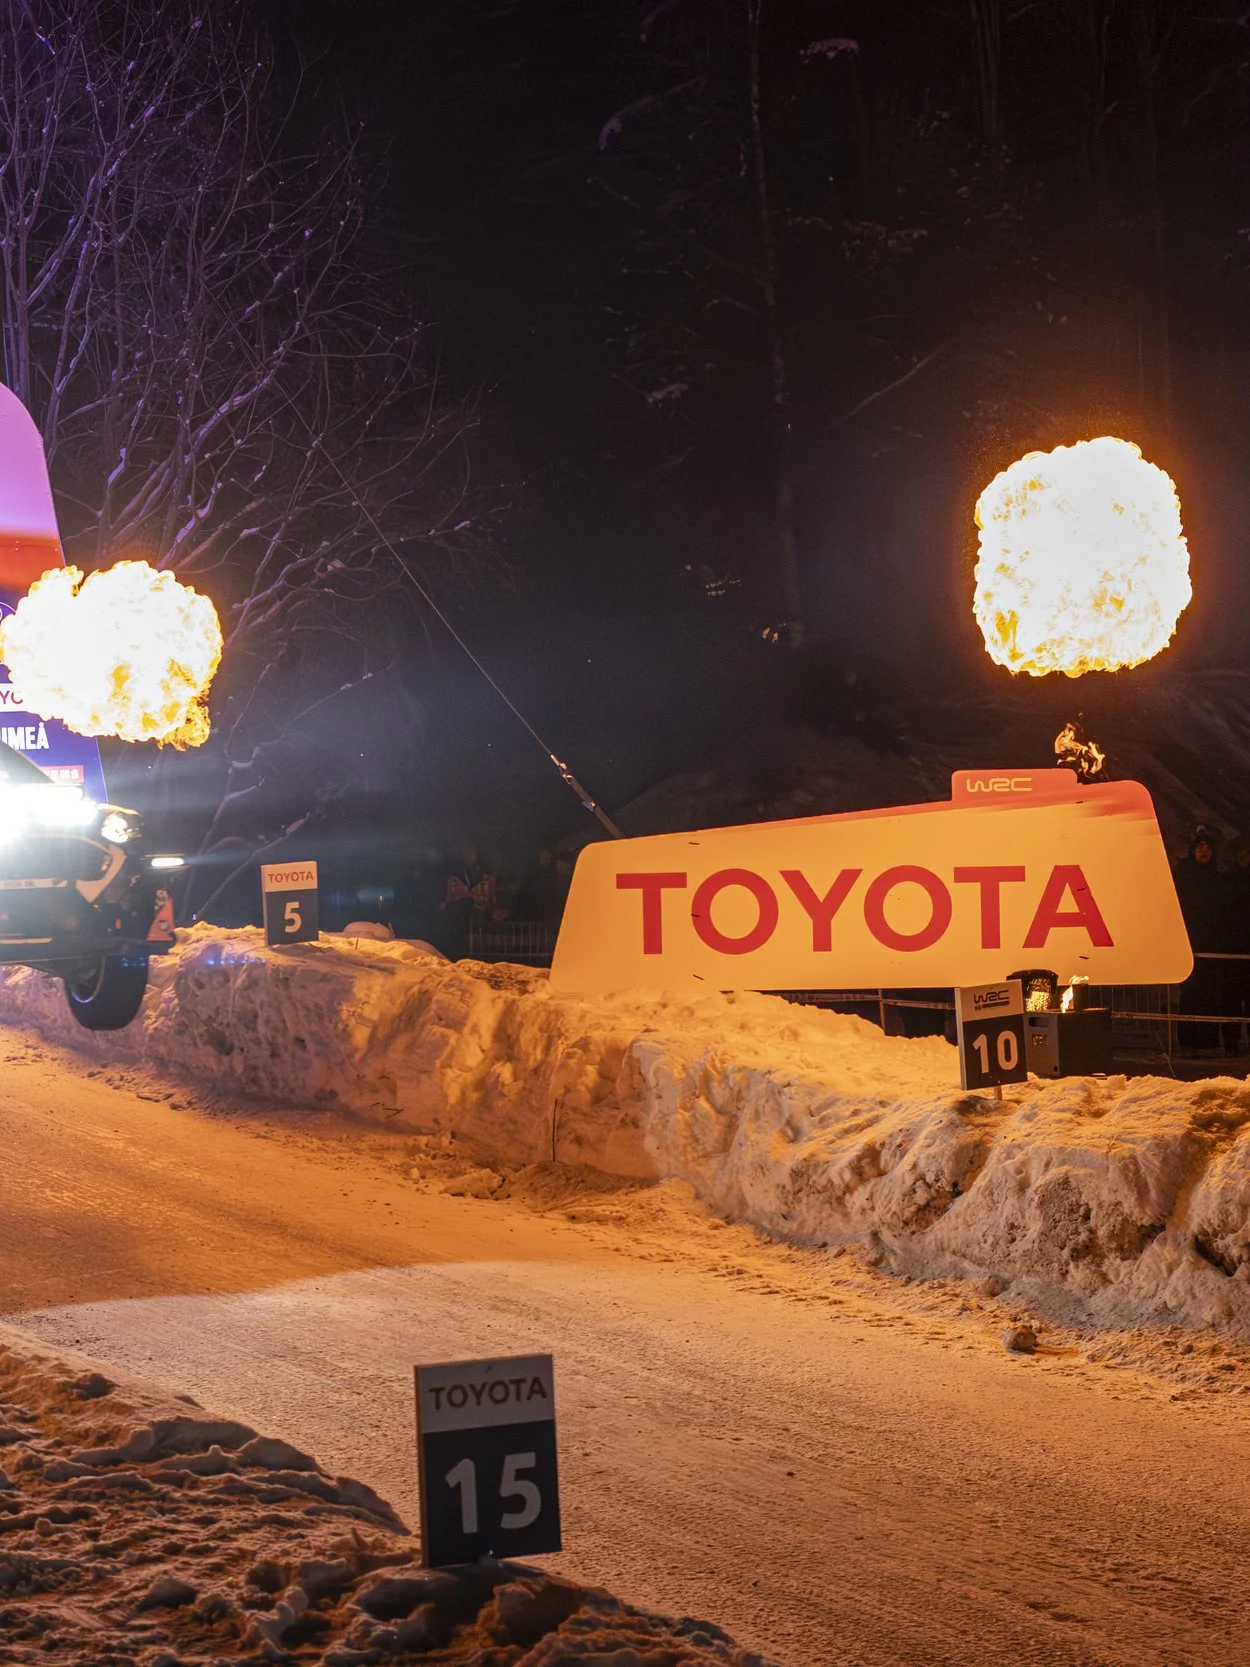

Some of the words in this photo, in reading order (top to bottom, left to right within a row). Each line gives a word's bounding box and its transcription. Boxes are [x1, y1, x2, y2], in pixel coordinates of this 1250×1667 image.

[966, 777, 1033, 793] WRC
[268, 871, 314, 883] TOYOTA
[284, 901, 302, 933] 5
[615, 864, 1115, 955] TOYOTA
[973, 989, 1010, 1004] WRC
[972, 1030, 1019, 1074] 10
[429, 1376, 548, 1411] TOYOTA
[445, 1452, 542, 1534] 15
